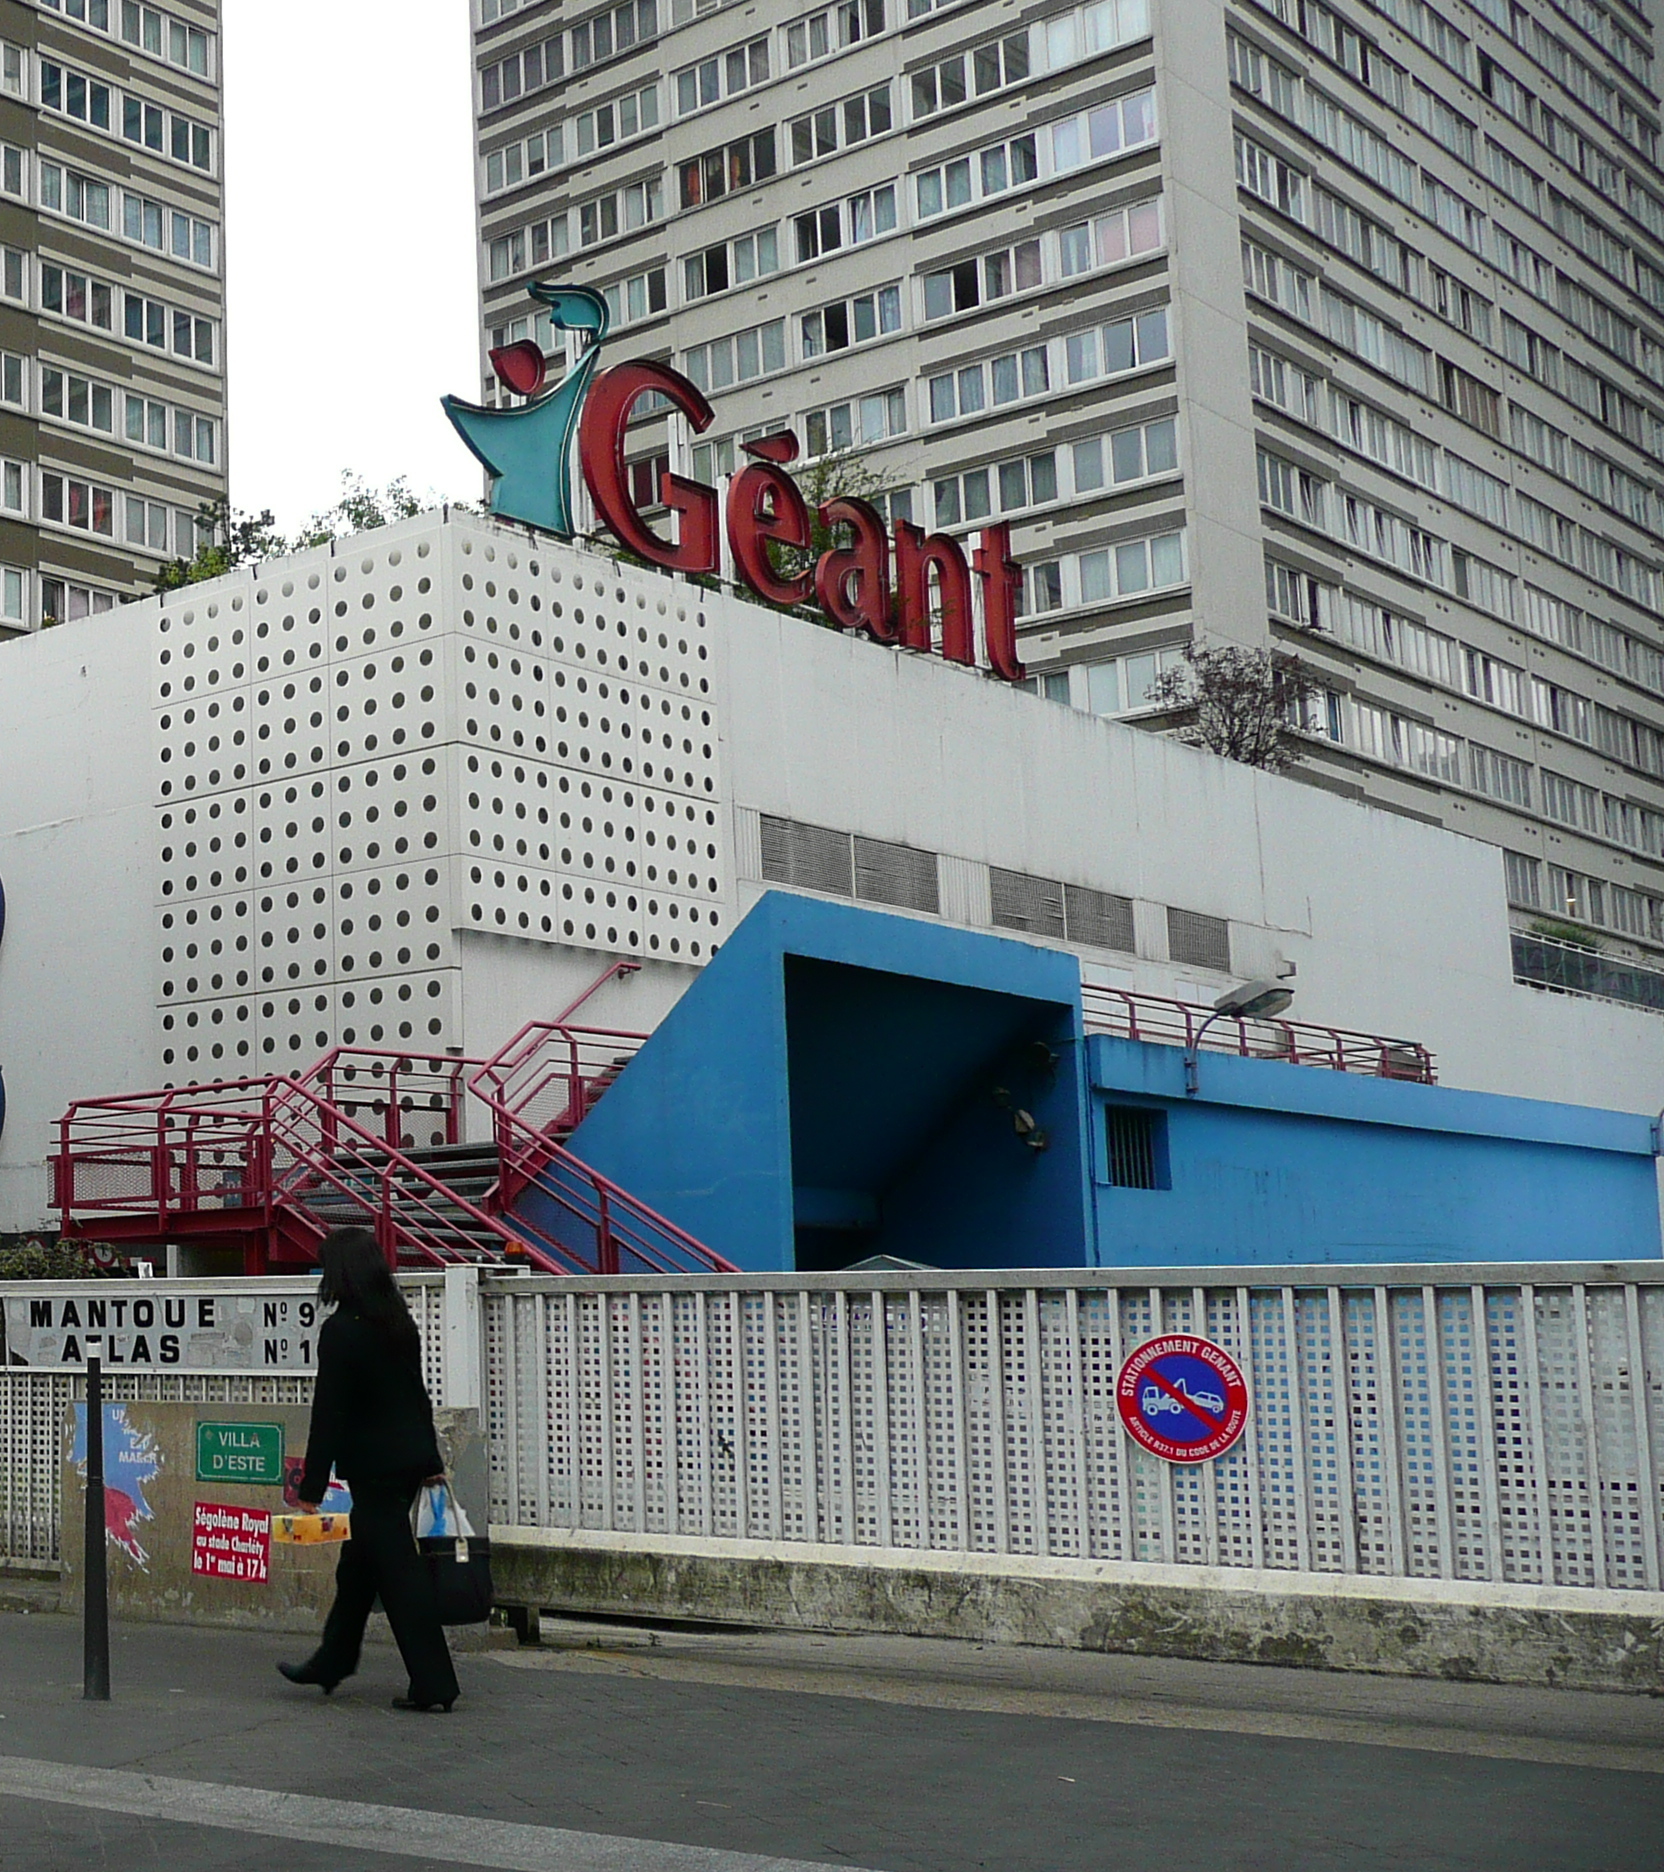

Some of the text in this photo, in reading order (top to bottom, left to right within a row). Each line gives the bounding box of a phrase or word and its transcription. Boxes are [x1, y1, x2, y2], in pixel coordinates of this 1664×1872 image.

[578, 359, 1026, 681] Géant
[30, 1299, 215, 1328] MANTOUE
[298, 1302, 315, 1328] 9
[1121, 1339, 1242, 1397] STATIONNEMENT GENANT
[218, 1431, 260, 1448] VILLA
[1129, 1415, 1155, 1445] ARTICLE
[1176, 1448, 1187, 1457] DU
[1189, 1446, 1211, 1457] CODE
[1209, 1439, 1221, 1450] DE
[1218, 1433, 1230, 1444] LA
[1226, 1409, 1242, 1434] ROUTE
[213, 1454, 266, 1472] D'ESTE
[195, 1506, 269, 1538] Ségolène Royal
[196, 1533, 264, 1559] au stade Charléty
[193, 1550, 203, 1570] le
[218, 1555, 235, 1574] mai
[237, 1556, 244, 1576] à
[247, 1558, 258, 1578] 17
